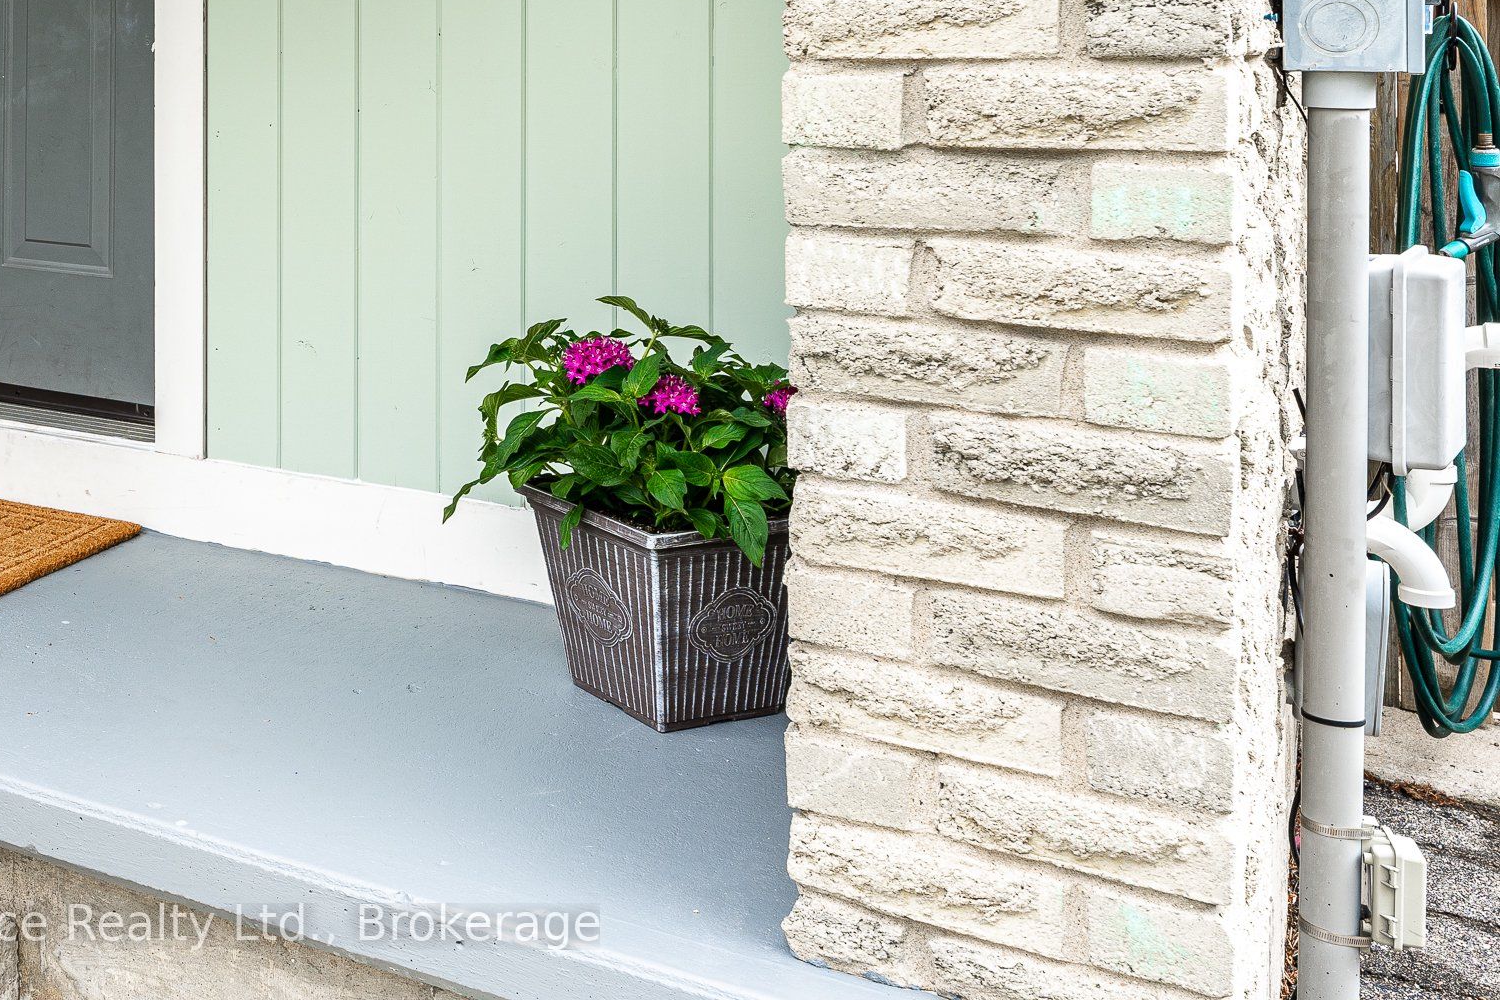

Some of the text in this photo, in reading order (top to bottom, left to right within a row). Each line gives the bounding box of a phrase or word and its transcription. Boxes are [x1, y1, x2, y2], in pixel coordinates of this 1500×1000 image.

[717, 604, 754, 621] HOME
[586, 609, 613, 634] HOME
[716, 632, 749, 647] HOME
